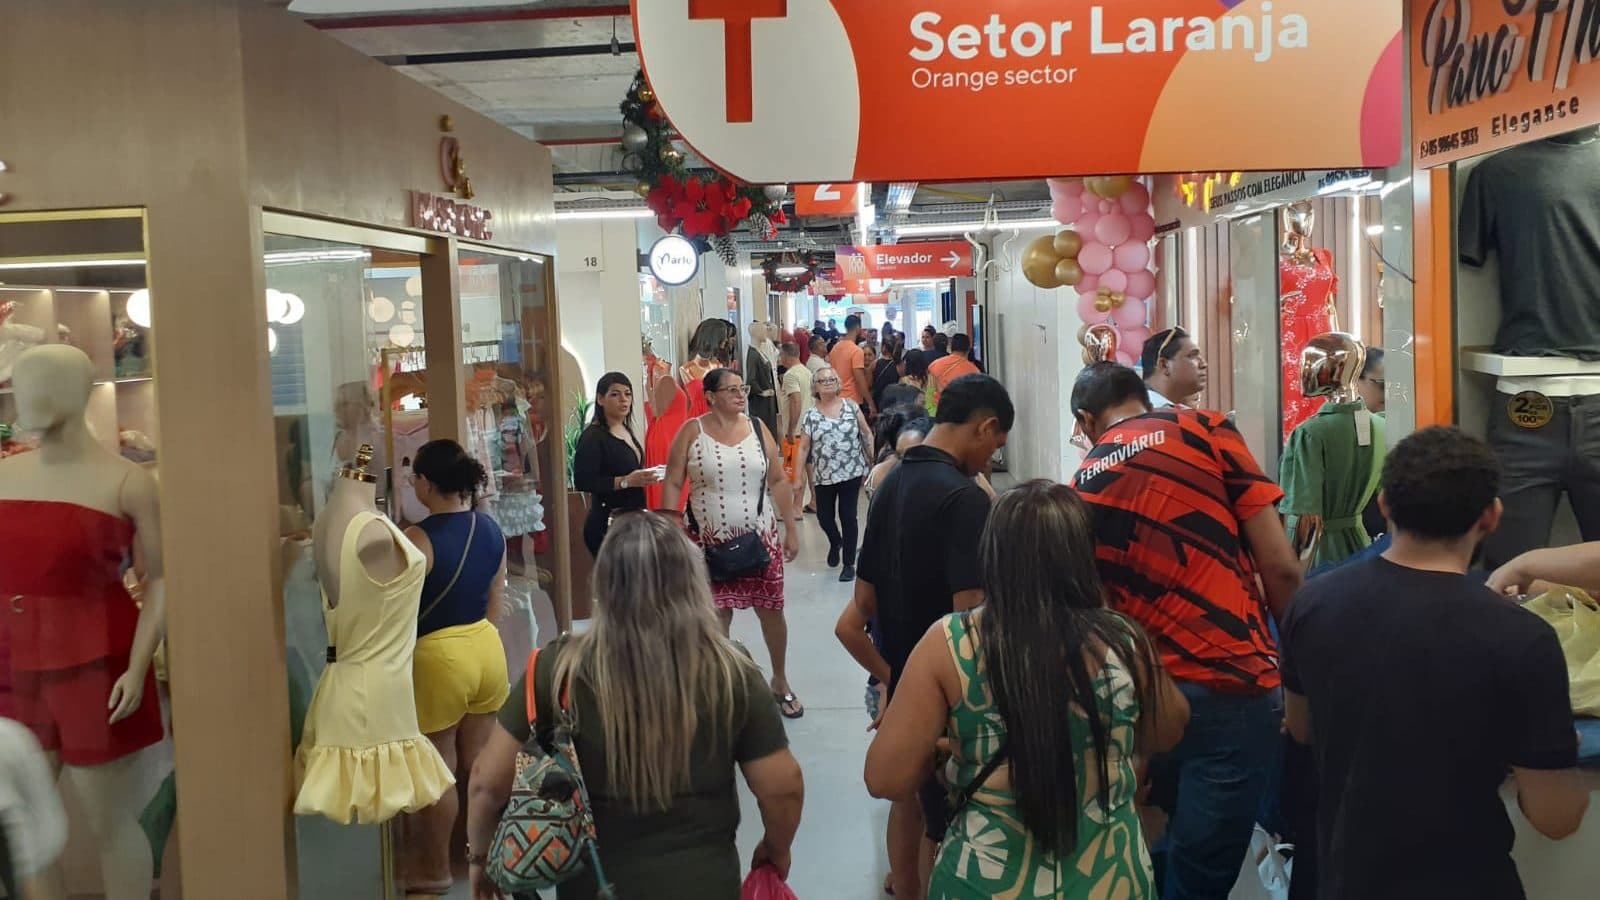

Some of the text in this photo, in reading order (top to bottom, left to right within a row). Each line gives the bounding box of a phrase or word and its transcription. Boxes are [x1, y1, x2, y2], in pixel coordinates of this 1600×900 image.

[909, 1, 1309, 62] Setor Laranja
[687, 0, 787, 122] T
[911, 64, 1077, 92] Orange sector
[1491, 96, 1579, 136] Elegance
[1223, 186, 1246, 204] PASSOS
[1246, 181, 1262, 197] COM
[584, 257, 597, 267] 18
[876, 252, 933, 265] Elevador
[1515, 397, 1529, 413] 2
[1080, 430, 1165, 484] FERROVIÁRIO
